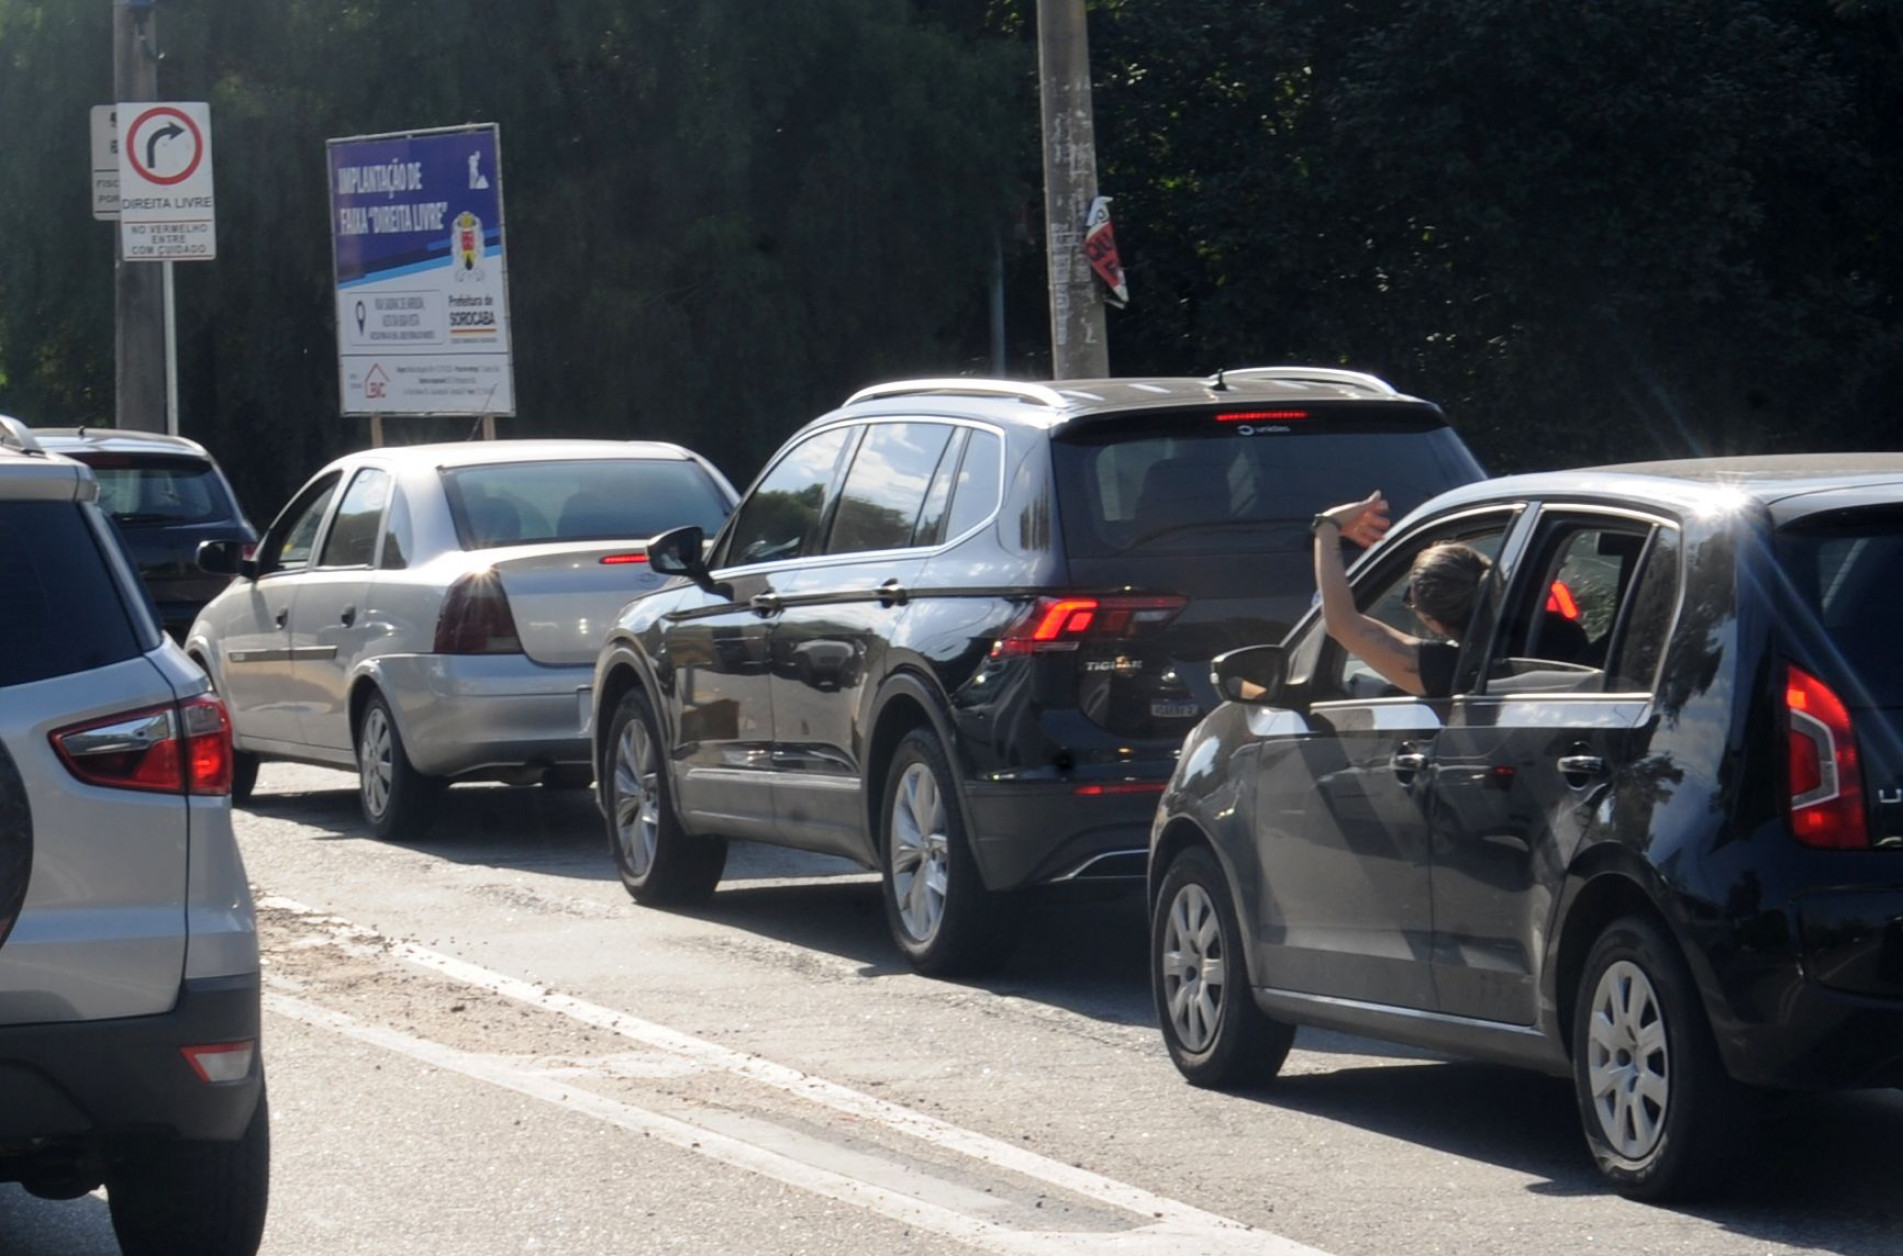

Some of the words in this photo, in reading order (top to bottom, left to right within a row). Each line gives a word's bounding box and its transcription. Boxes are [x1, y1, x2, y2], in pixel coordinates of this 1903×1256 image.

[407, 162, 423, 190] DE
[122, 198, 172, 210] DIREITA
[175, 196, 213, 209] LIVRE
[340, 206, 369, 235] FAIXA
[131, 226, 146, 235] NO
[150, 223, 208, 234] VERMELHO
[152, 235, 186, 245] ENTRE
[132, 246, 154, 255] COM
[157, 244, 207, 256] CUIDADO
[450, 310, 496, 327] SOROCABA
